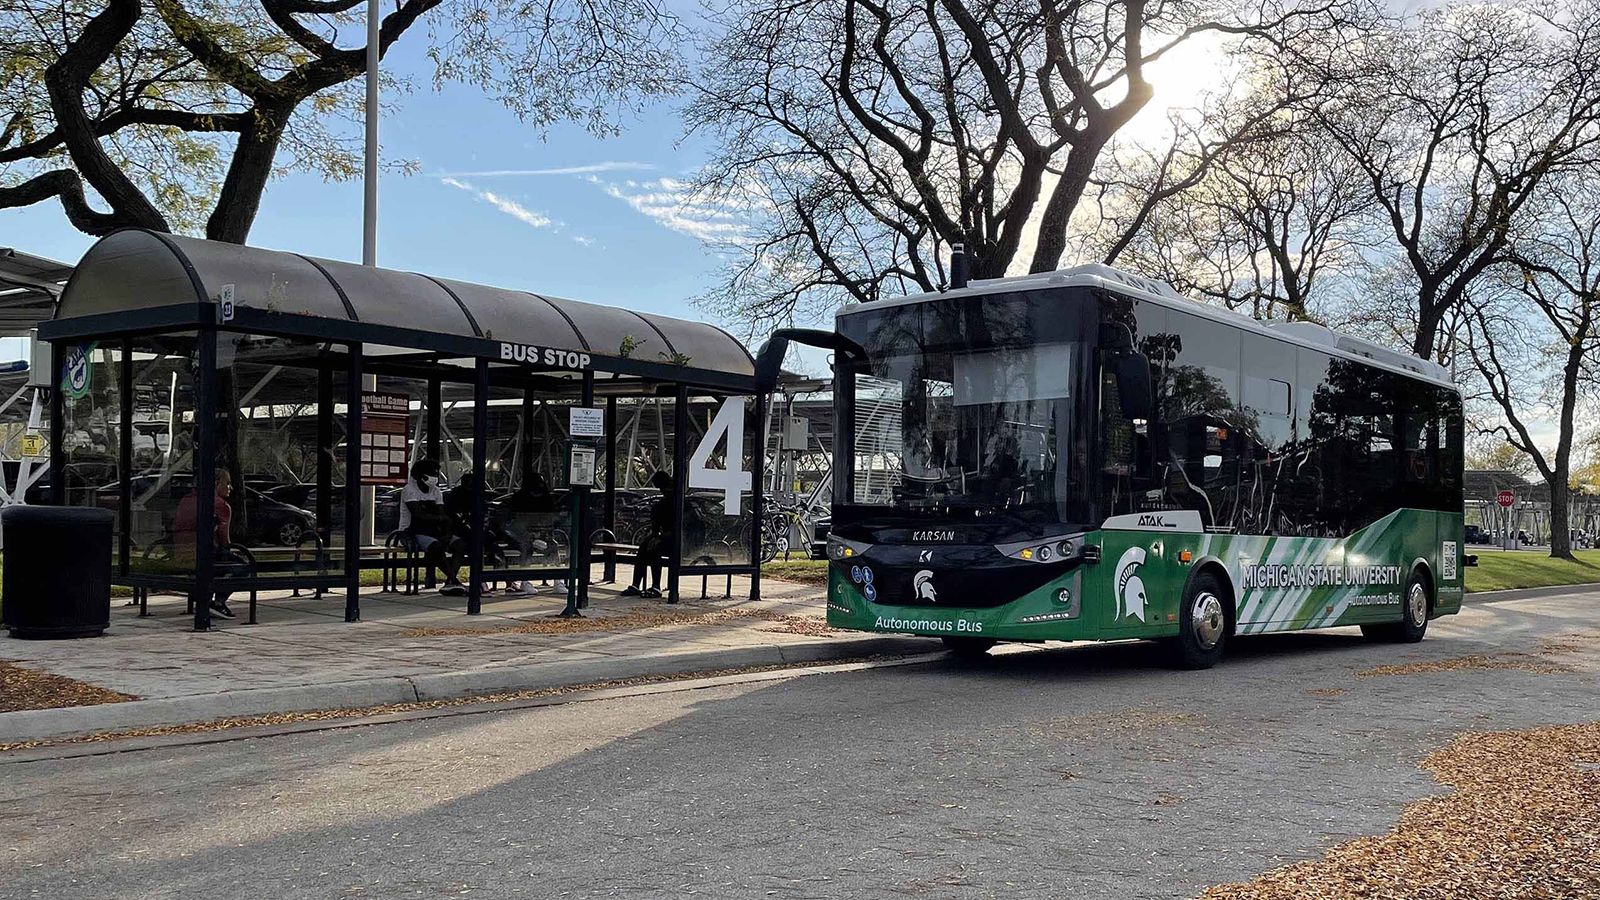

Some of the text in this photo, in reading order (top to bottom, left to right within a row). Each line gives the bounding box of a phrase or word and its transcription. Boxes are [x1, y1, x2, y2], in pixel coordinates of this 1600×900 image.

[500, 342, 591, 369] BUS STOP
[361, 395, 408, 406] ootball Game
[688, 396, 753, 516] 4
[1498, 495, 1514, 503] STOP
[912, 530, 955, 541] KARSAN
[1241, 564, 1401, 589] MICHIGAN STATE UNIVERSITY
[1347, 592, 1400, 607] Autonomous Bus
[874, 616, 983, 632] Autonomous Bus
